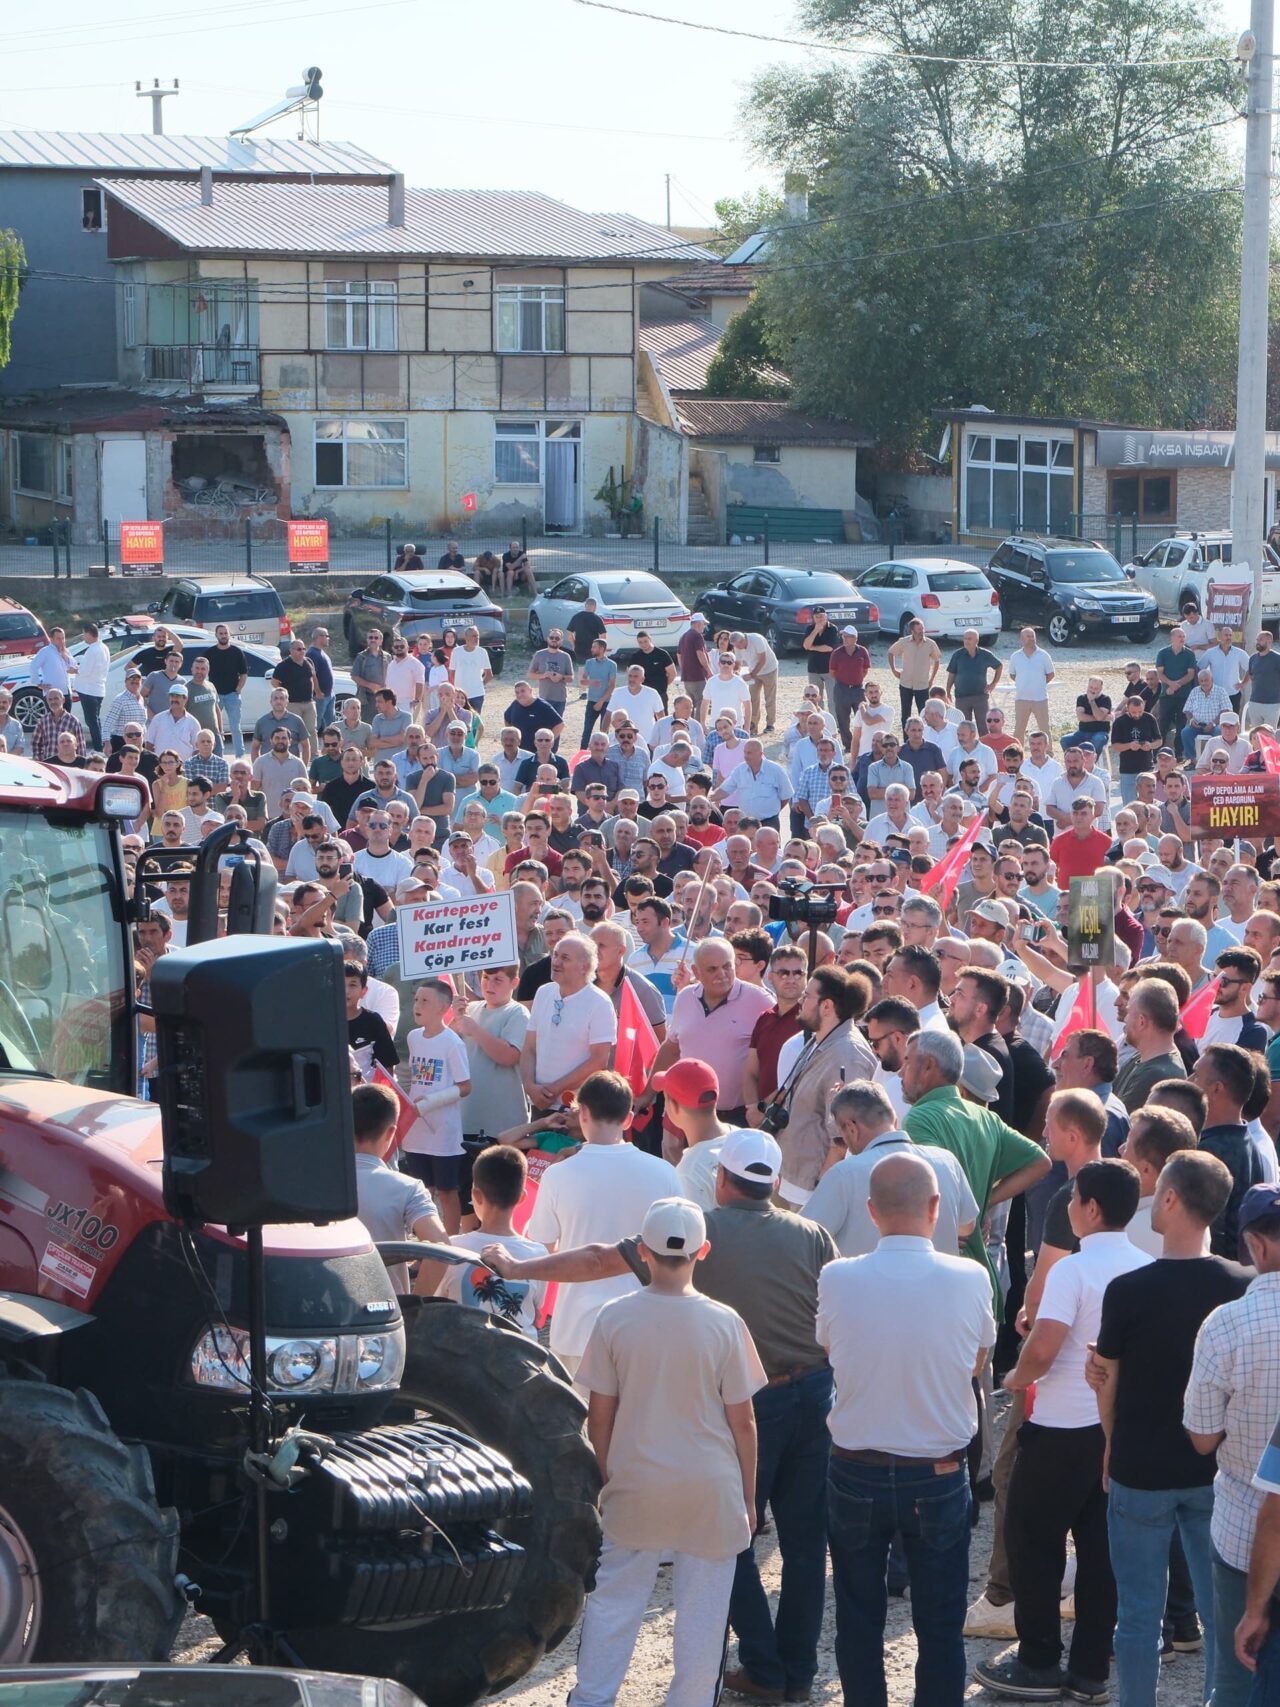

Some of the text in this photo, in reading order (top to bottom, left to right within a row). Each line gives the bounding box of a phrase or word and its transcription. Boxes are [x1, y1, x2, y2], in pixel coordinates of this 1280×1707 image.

[126, 536, 157, 549] HAYIR!
[293, 535, 323, 548] HAYIR!
[1216, 786, 1247, 795] DEPOLAMA
[1247, 785, 1264, 794] ALANI
[1209, 806, 1259, 827] HAYIR!
[413, 901, 498, 921] Kartepeye
[1079, 900, 1101, 942] YEŞİL
[424, 917, 490, 935] Kar fest
[414, 932, 502, 953] Kandıraya
[424, 947, 494, 970] Çöp Fest
[47, 1201, 119, 1250] JX100
[367, 1302, 388, 1312] CASE
